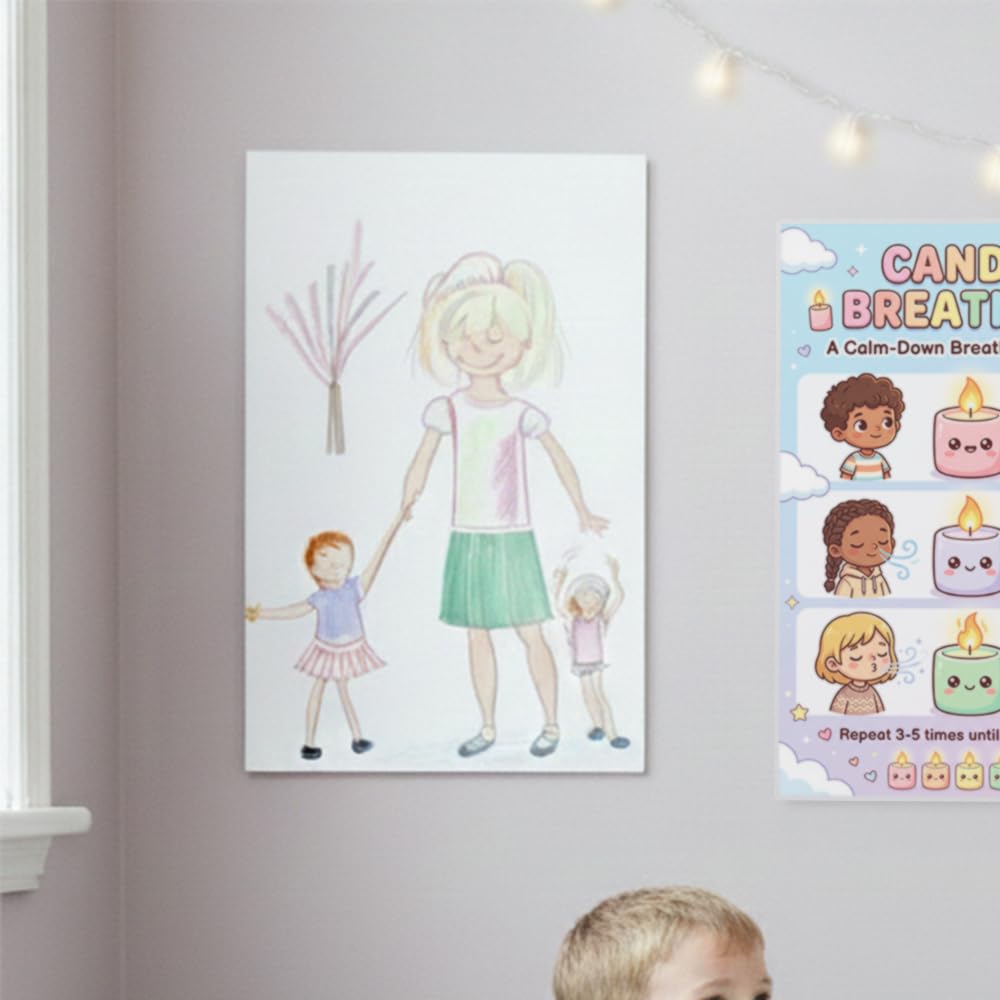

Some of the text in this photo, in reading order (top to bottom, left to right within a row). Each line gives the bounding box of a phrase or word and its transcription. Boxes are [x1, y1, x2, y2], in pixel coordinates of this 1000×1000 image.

[827, 341, 838, 354] A
[844, 340, 944, 355] Calm-Down
[840, 728, 891, 743] Repeat
[896, 728, 920, 740] 3-5
[925, 729, 964, 741] times
[969, 729, 999, 741] until
